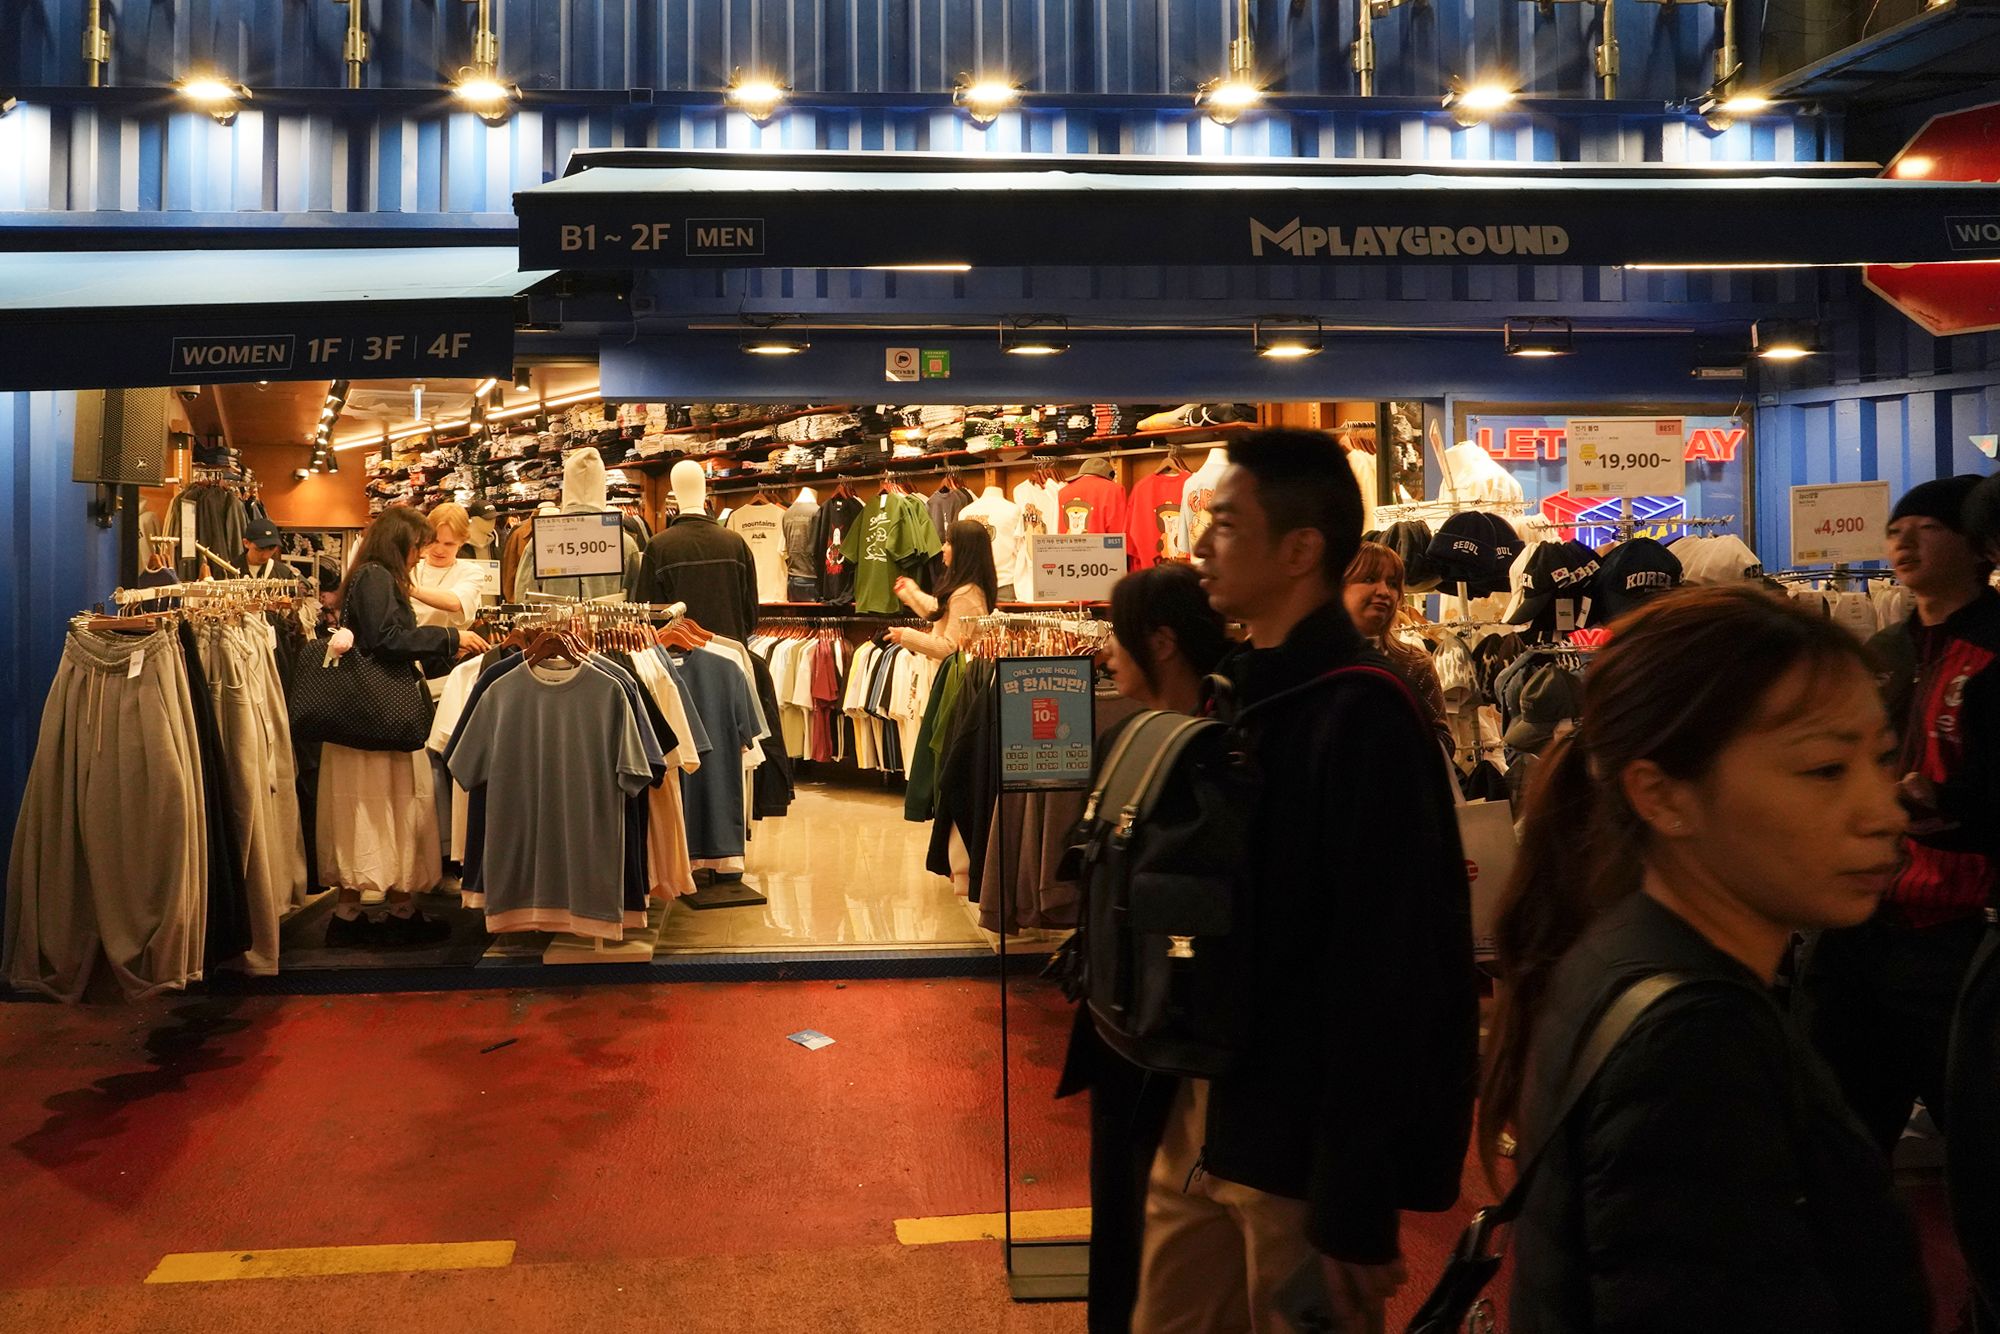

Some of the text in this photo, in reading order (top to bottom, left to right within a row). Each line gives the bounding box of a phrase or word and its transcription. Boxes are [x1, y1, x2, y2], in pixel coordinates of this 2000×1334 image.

[561, 224, 596, 251] B1
[631, 223, 671, 251] 2F
[697, 227, 754, 247] MEN
[182, 332, 472, 367] WOMEN 1F 3F 4F
[1452, 540, 1479, 556] SEOUL
[1496, 546, 1513, 556] OUL
[1012, 666, 1078, 678] ONLY ONE HOUR
